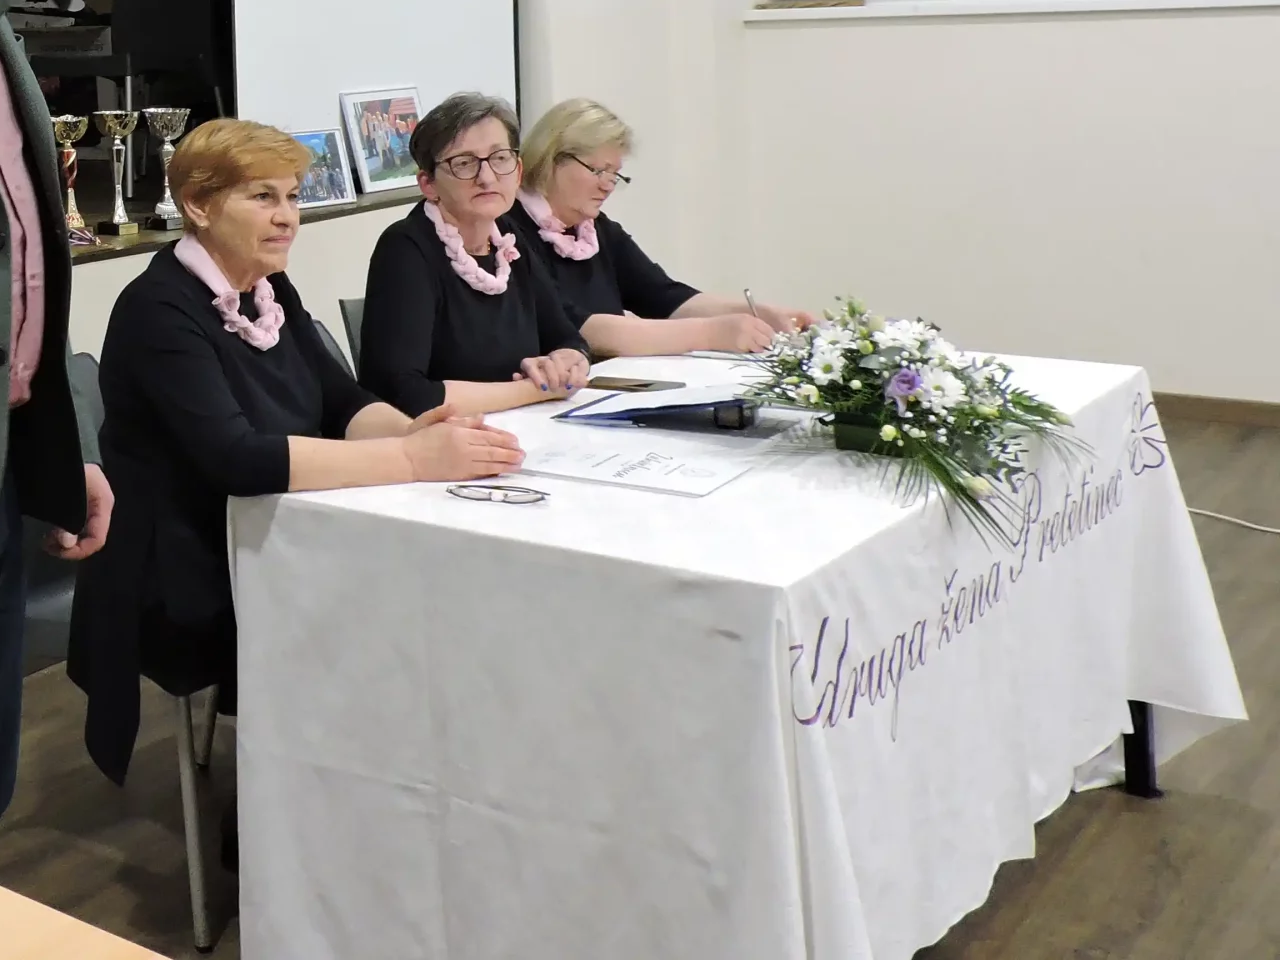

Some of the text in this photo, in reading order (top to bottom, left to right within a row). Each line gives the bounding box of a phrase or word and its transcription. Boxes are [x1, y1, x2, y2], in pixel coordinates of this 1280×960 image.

[789, 464, 1123, 742] Udruga žena Pretetinec
